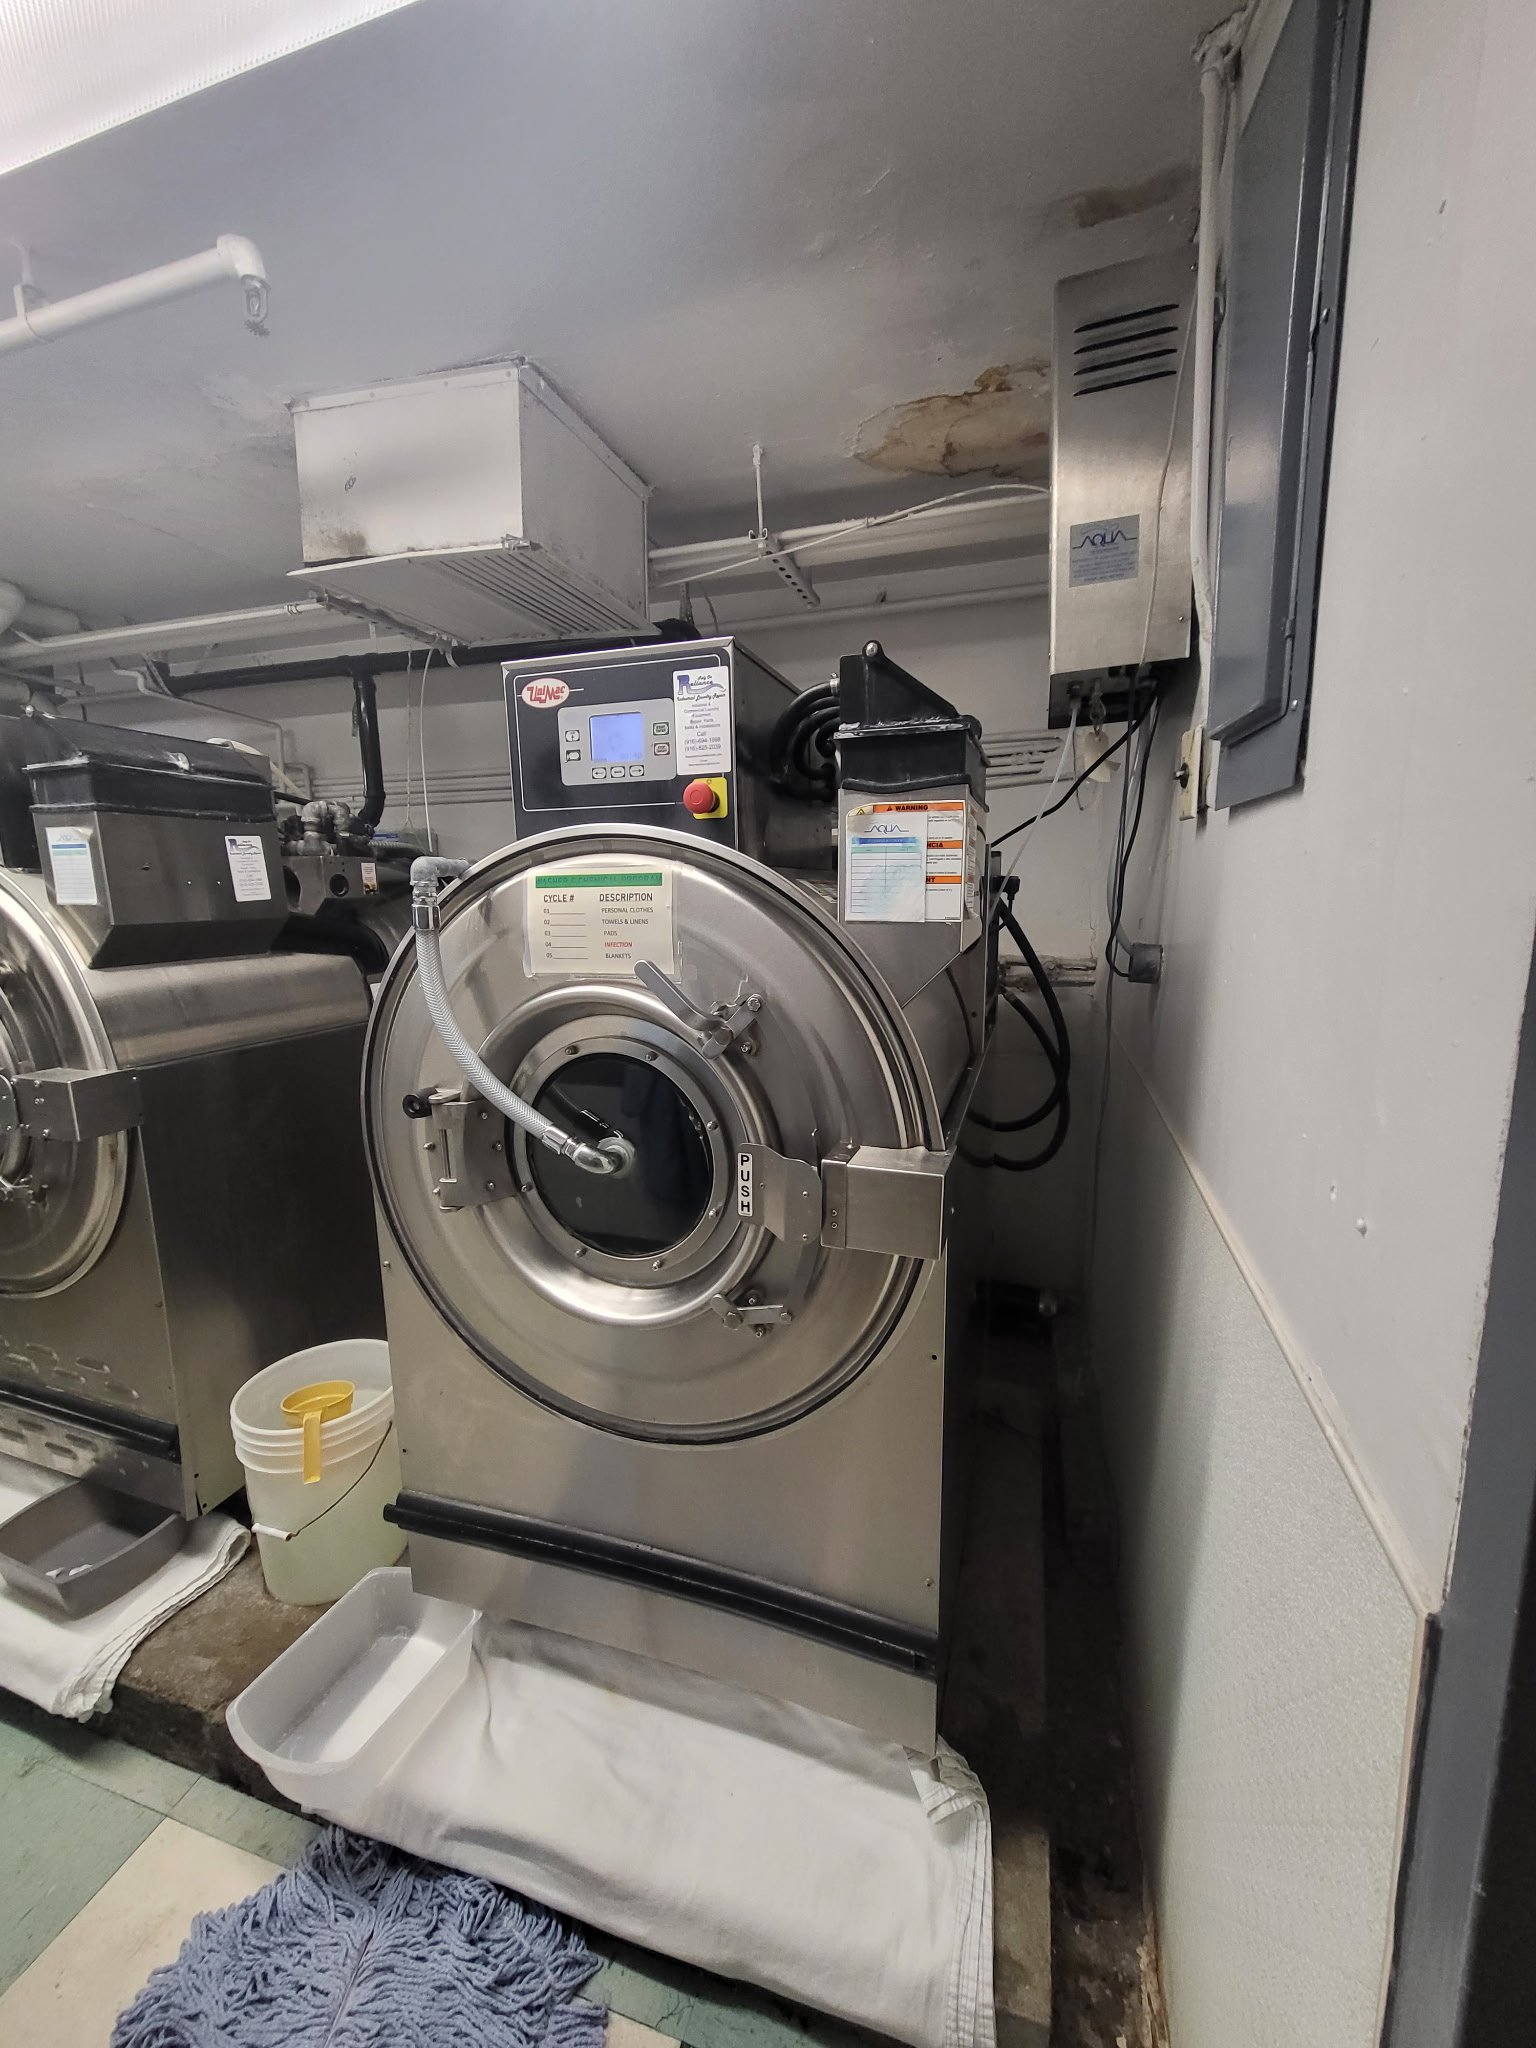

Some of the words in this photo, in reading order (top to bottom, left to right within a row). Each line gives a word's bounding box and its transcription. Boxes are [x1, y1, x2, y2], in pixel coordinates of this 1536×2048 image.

[1072, 530, 1137, 549] AQUA
[864, 825, 909, 834] AQUA
[543, 894, 567, 903] CYCLE
[600, 893, 653, 902] DESCRIPTION
[740, 1154, 750, 1213] PUSH
